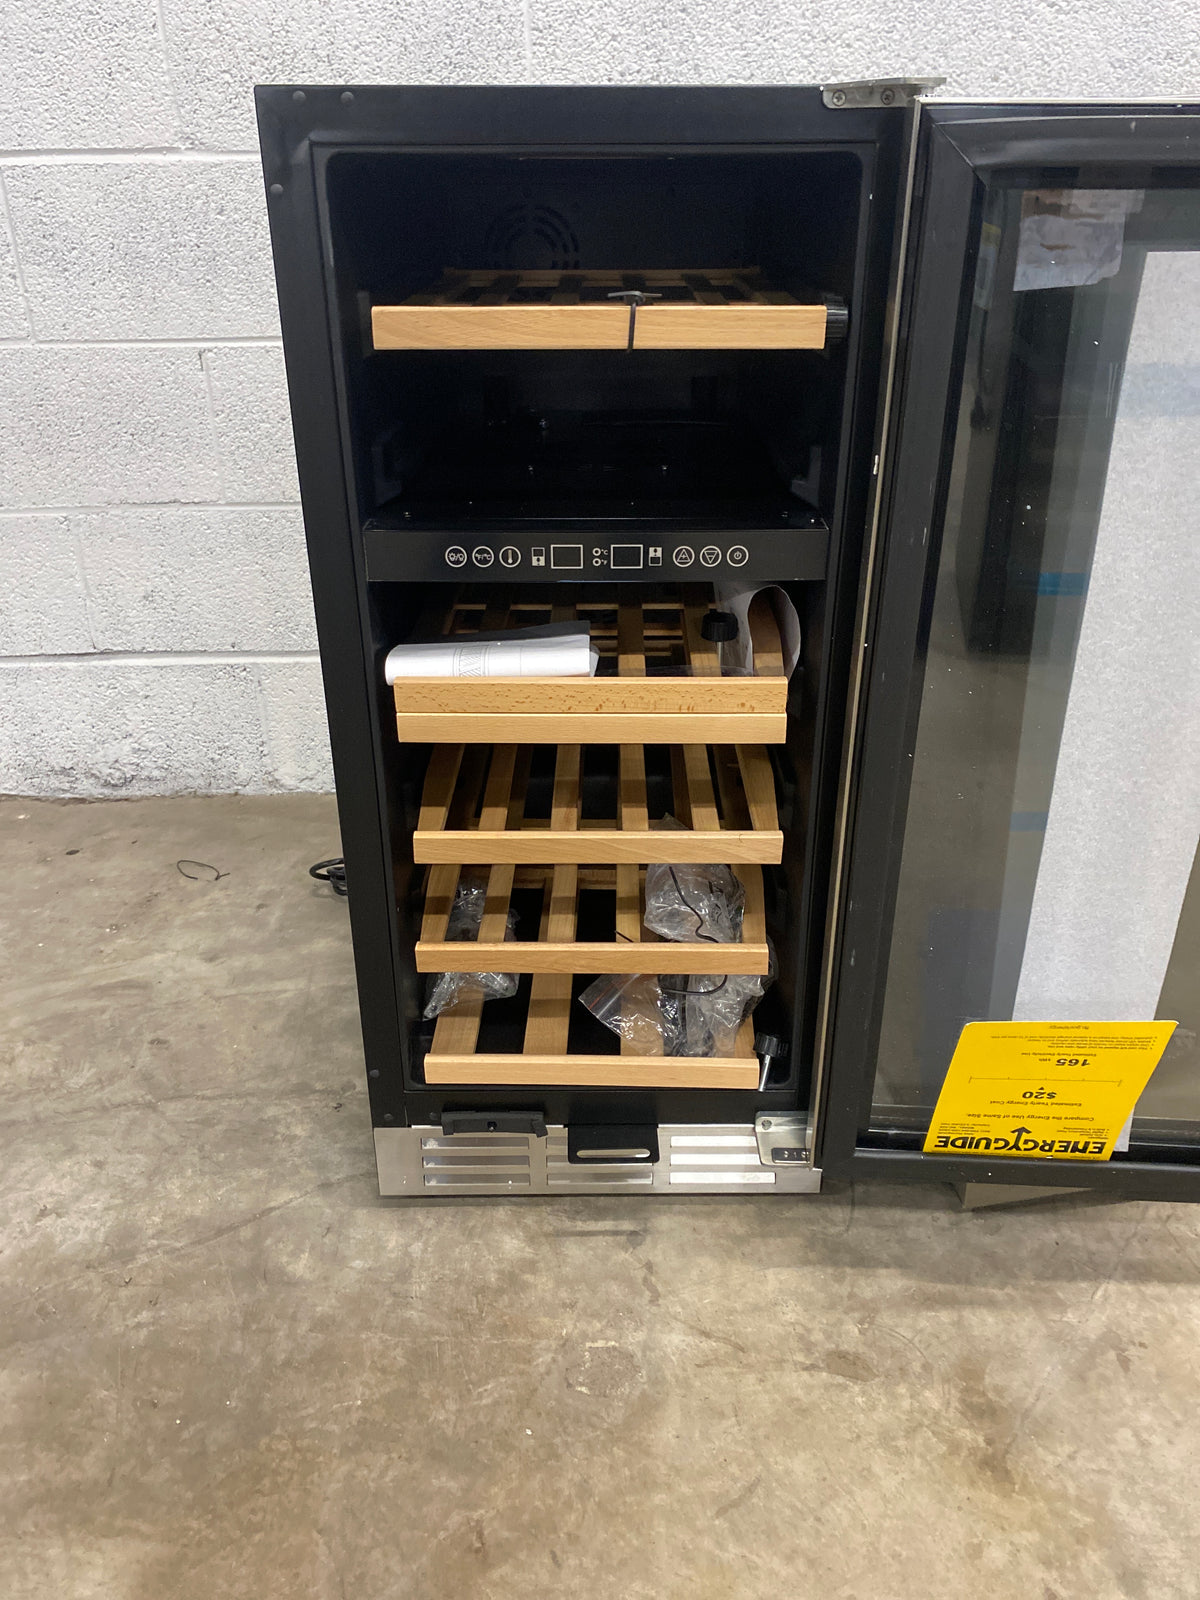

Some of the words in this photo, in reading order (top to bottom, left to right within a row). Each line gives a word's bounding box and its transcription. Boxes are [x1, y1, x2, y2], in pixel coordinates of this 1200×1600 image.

[1056, 1058, 1090, 1066] 165
[1022, 1091, 1057, 1100] $20
[934, 1135, 1106, 1154] ENERGYGUIDE
